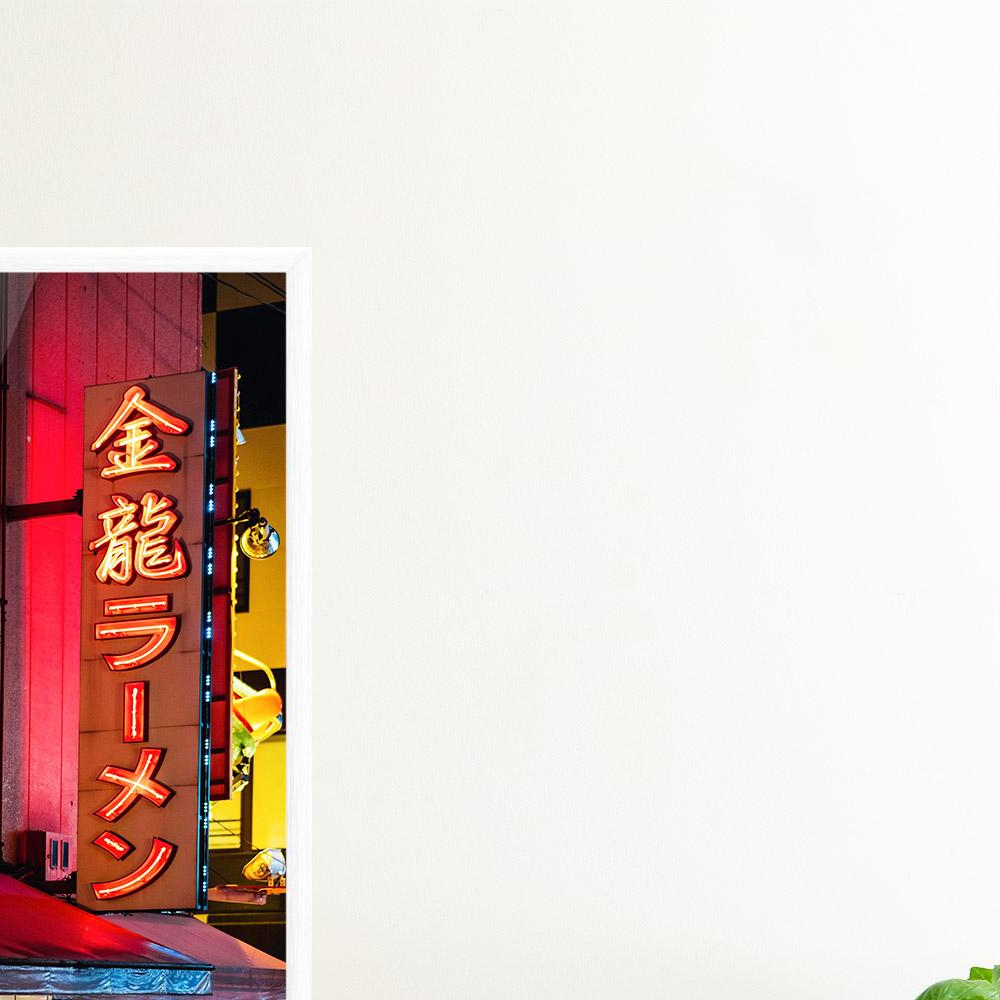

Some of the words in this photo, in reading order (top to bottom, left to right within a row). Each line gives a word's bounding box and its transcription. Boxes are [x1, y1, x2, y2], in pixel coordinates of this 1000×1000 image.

[89, 384, 191, 900] 金龍ラーメン
